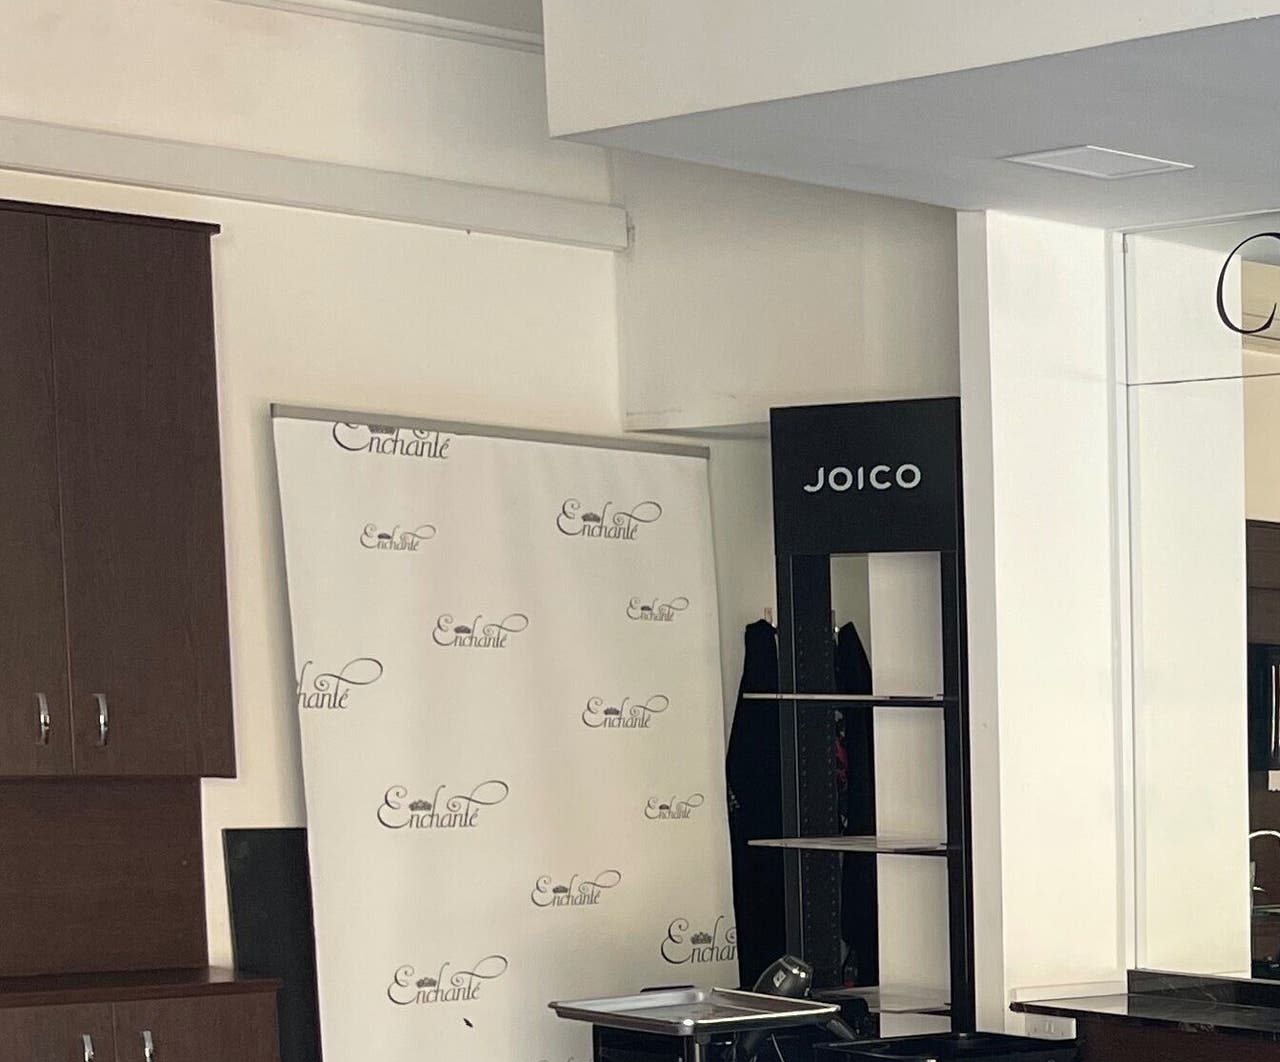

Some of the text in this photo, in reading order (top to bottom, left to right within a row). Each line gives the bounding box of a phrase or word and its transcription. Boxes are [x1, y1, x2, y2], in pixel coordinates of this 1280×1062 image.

[803, 463, 922, 493] JOICO
[556, 498, 663, 541] Enchanté
[431, 613, 529, 649] Enchanté
[298, 657, 384, 710] hanté
[581, 694, 670, 729] Enchanté
[376, 779, 510, 829] Enchanté
[530, 869, 622, 908] Enchanté
[660, 915, 737, 965] Encha
[386, 954, 509, 1006] Enchanté
